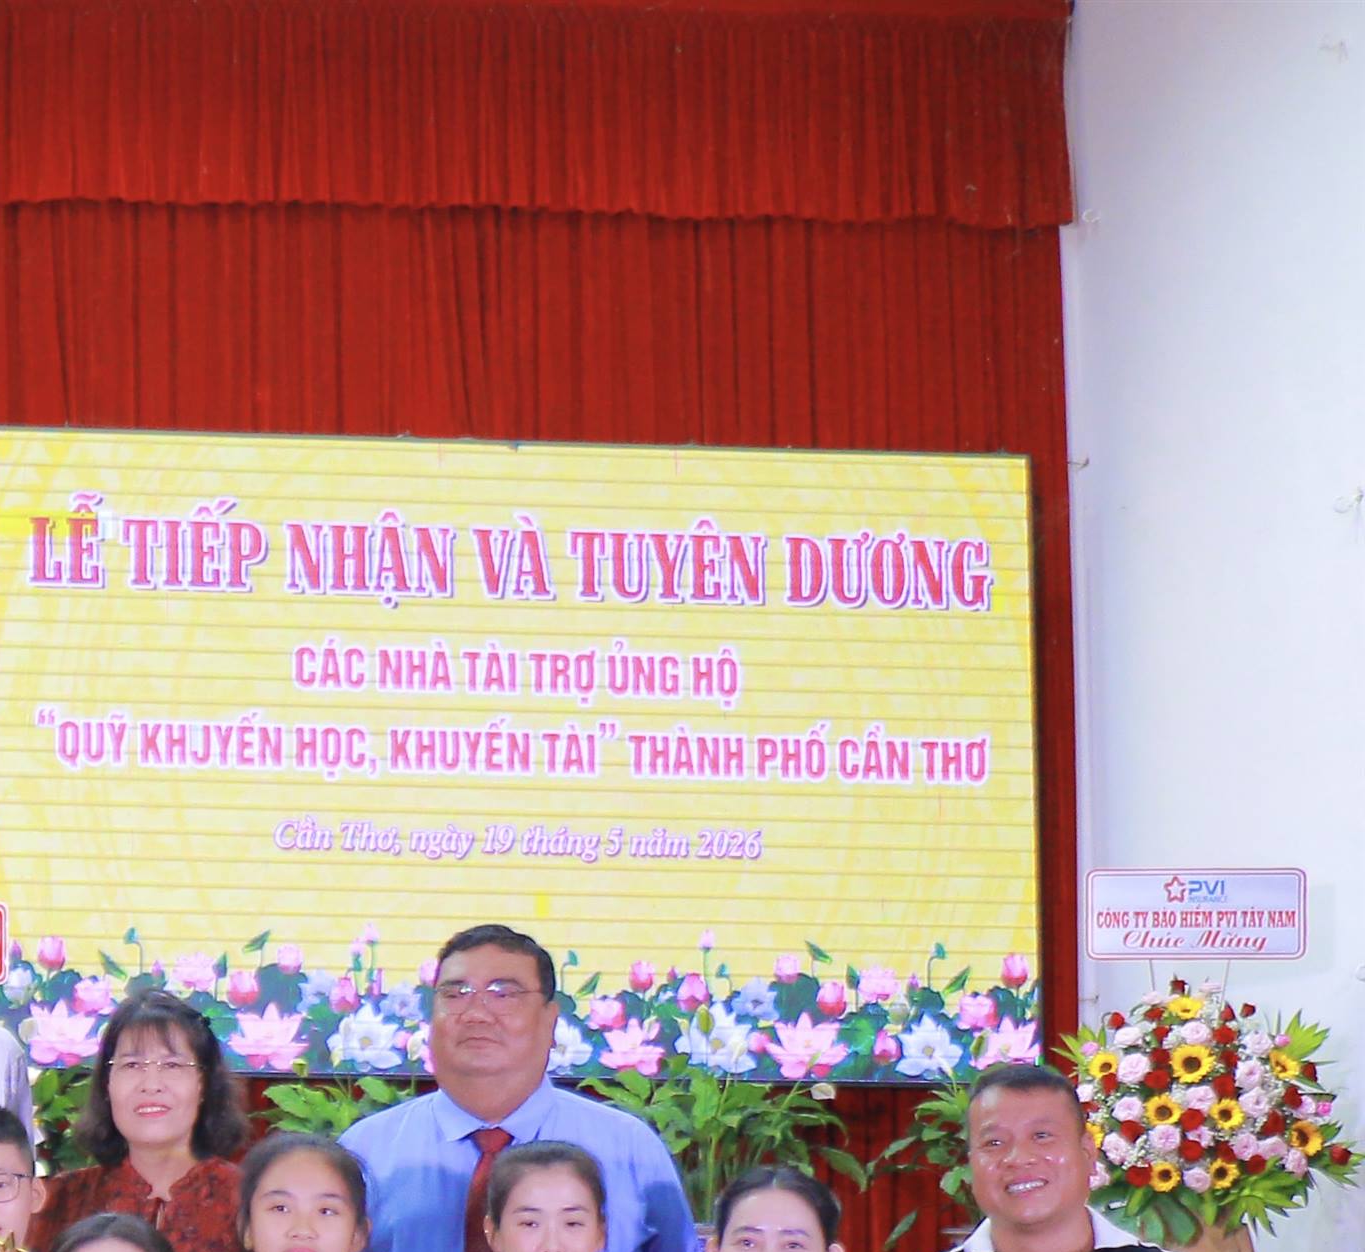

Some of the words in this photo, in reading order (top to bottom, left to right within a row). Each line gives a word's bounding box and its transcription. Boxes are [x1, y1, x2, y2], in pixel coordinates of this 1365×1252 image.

[28, 494, 103, 586] LỄ
[121, 499, 267, 589] TIẾP
[285, 510, 453, 608] NHẬN
[472, 514, 552, 600] VÀ
[569, 518, 763, 604] TUYÊN
[784, 531, 990, 610] DƯƠNG
[294, 638, 366, 688] CÁC
[378, 641, 452, 690] NHÀ
[462, 642, 518, 691] TÀI
[529, 650, 596, 705] TRỢ
[607, 640, 679, 696] ỦNG
[692, 648, 738, 706] HỘ
[295, 726, 377, 779] HỌC,
[390, 717, 531, 774] KHUYẾN
[542, 722, 617, 775] TÀI”
[629, 727, 744, 778] THÀNH
[757, 723, 828, 778] PHỐ
[838, 725, 909, 780] CẦN
[921, 738, 987, 782] THƠ
[274, 816, 334, 852] Cần
[340, 822, 402, 854] Thơ,
[410, 826, 474, 860] ngày
[482, 825, 515, 855] 19
[520, 826, 600, 862] tháng
[606, 828, 623, 857] 5
[629, 829, 689, 858] năm
[697, 829, 762, 859] 2026
[1189, 880, 1226, 896] PVI
[1097, 907, 1129, 928] CÔNG
[1134, 911, 1150, 928] TY
[1152, 907, 1176, 928] BẢO
[1180, 904, 1213, 928] HIỂM
[1217, 911, 1238, 928] PVI
[1241, 906, 1265, 928] TÂY
[1268, 911, 1296, 928] NAM
[1123, 929, 1185, 950] Chúc
[1192, 929, 1269, 951] Mừng
